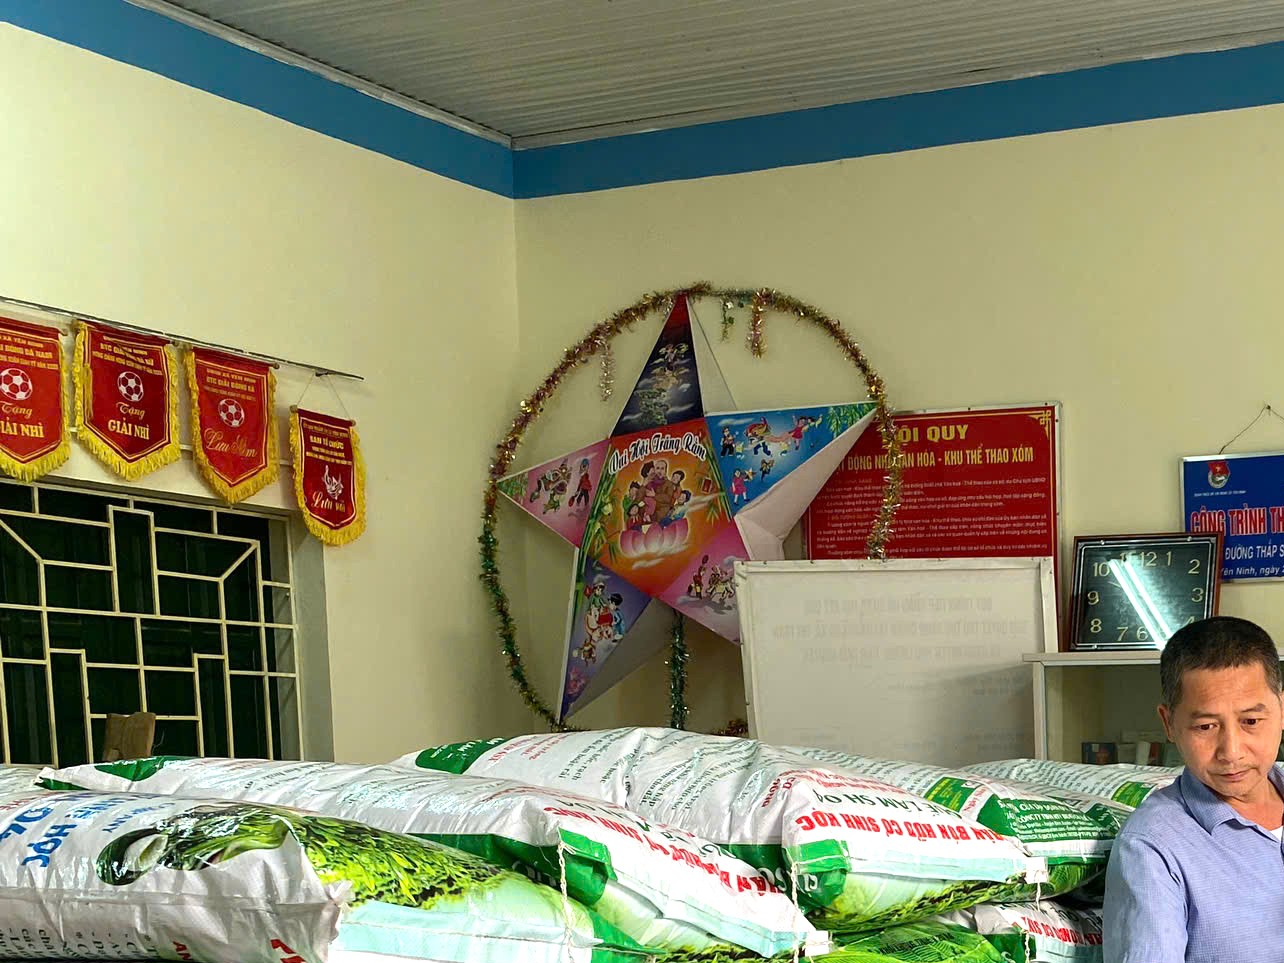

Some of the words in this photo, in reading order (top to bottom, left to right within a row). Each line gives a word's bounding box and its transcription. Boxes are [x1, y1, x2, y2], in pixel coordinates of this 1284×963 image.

[0, 417, 17, 436] IẢI
[20, 422, 44, 438] NHÌ
[108, 418, 132, 436] GIẢI
[134, 423, 149, 440] NHÌ
[927, 424, 968, 442] QUY
[917, 448, 936, 466] HÓA
[944, 450, 964, 465] KHU
[966, 443, 983, 464] THỂ
[985, 448, 1009, 464] THAO
[1012, 446, 1034, 463] XÓM
[1229, 504, 1266, 536] TRÌNH
[1139, 552, 1157, 567] 12
[1166, 552, 1171, 566] 1
[1188, 559, 1200, 574] 2
[1093, 562, 1110, 577] 10
[1260, 564, 1280, 576] ngày
[1088, 591, 1099, 605] 9
[1192, 588, 1204, 602] 3
[1090, 618, 1102, 632] 8
[1117, 627, 1128, 641] 7
[1137, 627, 1148, 640] 6
[798, 807, 840, 832] HỌC
[842, 812, 881, 832] SINH
[904, 821, 937, 842] HỮU
